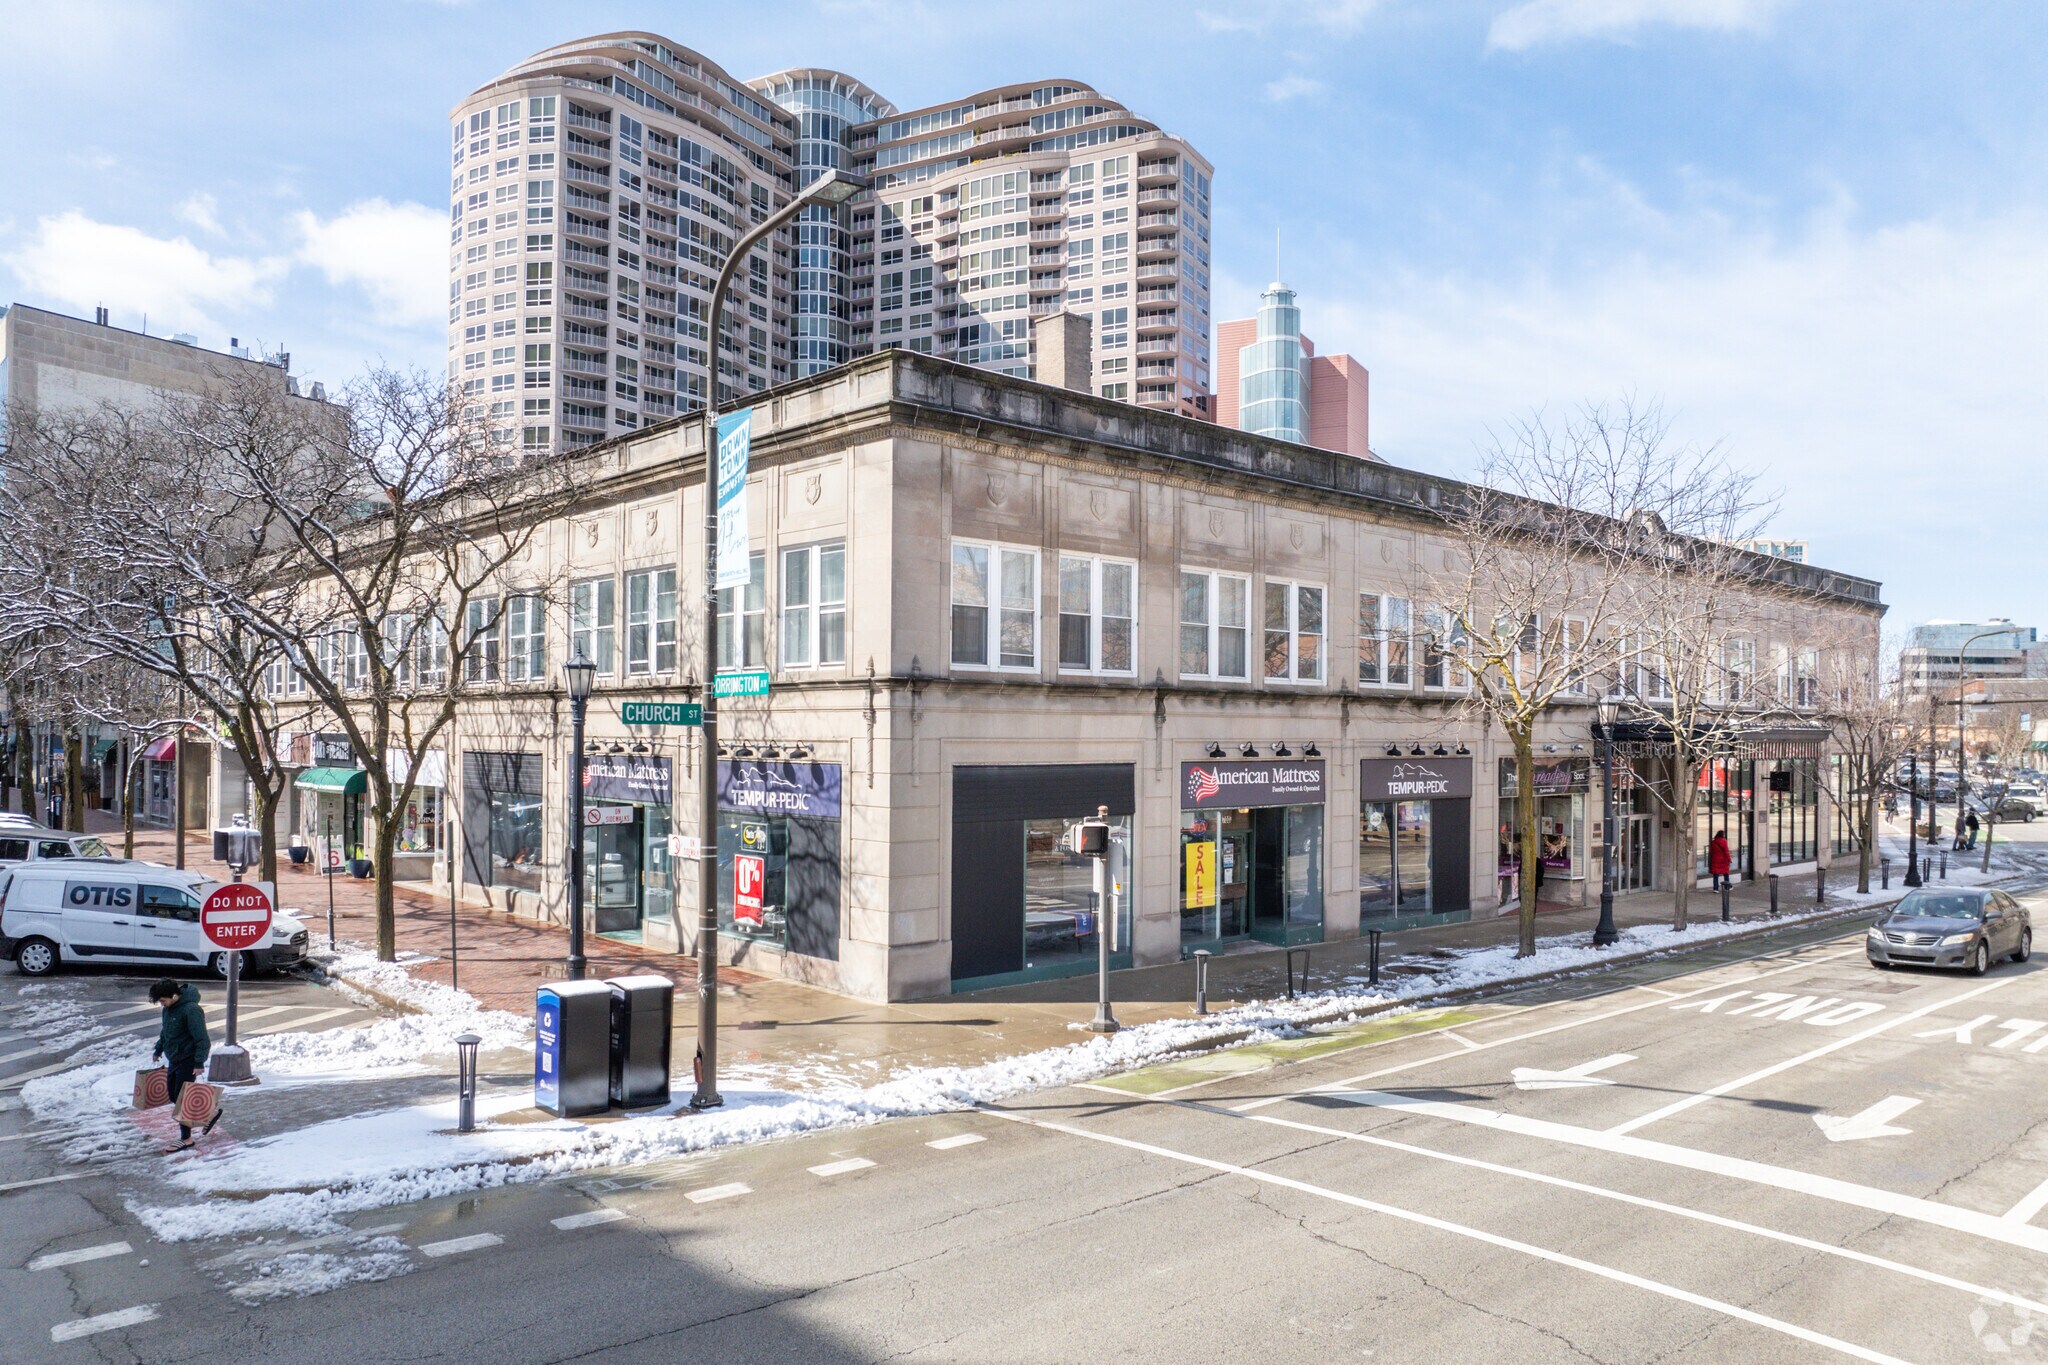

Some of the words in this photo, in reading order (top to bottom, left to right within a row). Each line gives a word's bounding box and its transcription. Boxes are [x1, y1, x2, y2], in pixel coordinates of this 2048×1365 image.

[720, 424, 748, 462] DOWN
[720, 444, 746, 479] TOWN
[715, 675, 760, 694] ORRINGTON
[625, 704, 681, 722] CHURCH
[688, 710, 698, 719] ST
[587, 760, 627, 778] American
[628, 763, 668, 781] Mattress
[1211, 766, 1269, 785] American
[1272, 767, 1320, 784] Mattress
[1272, 786, 1285, 794] Family
[1304, 785, 1320, 793] Operated
[1387, 780, 1448, 795] TEMPUR-PEDIC
[731, 789, 811, 810] TEMPUR-PEDIC
[738, 858, 760, 894] 0%
[1194, 844, 1205, 905] SALE
[70, 885, 132, 907] OTIS
[212, 897, 230, 908] DO
[236, 895, 263, 907] NOT
[216, 925, 257, 938] ENTER
[1668, 990, 1886, 1026] ONLY
